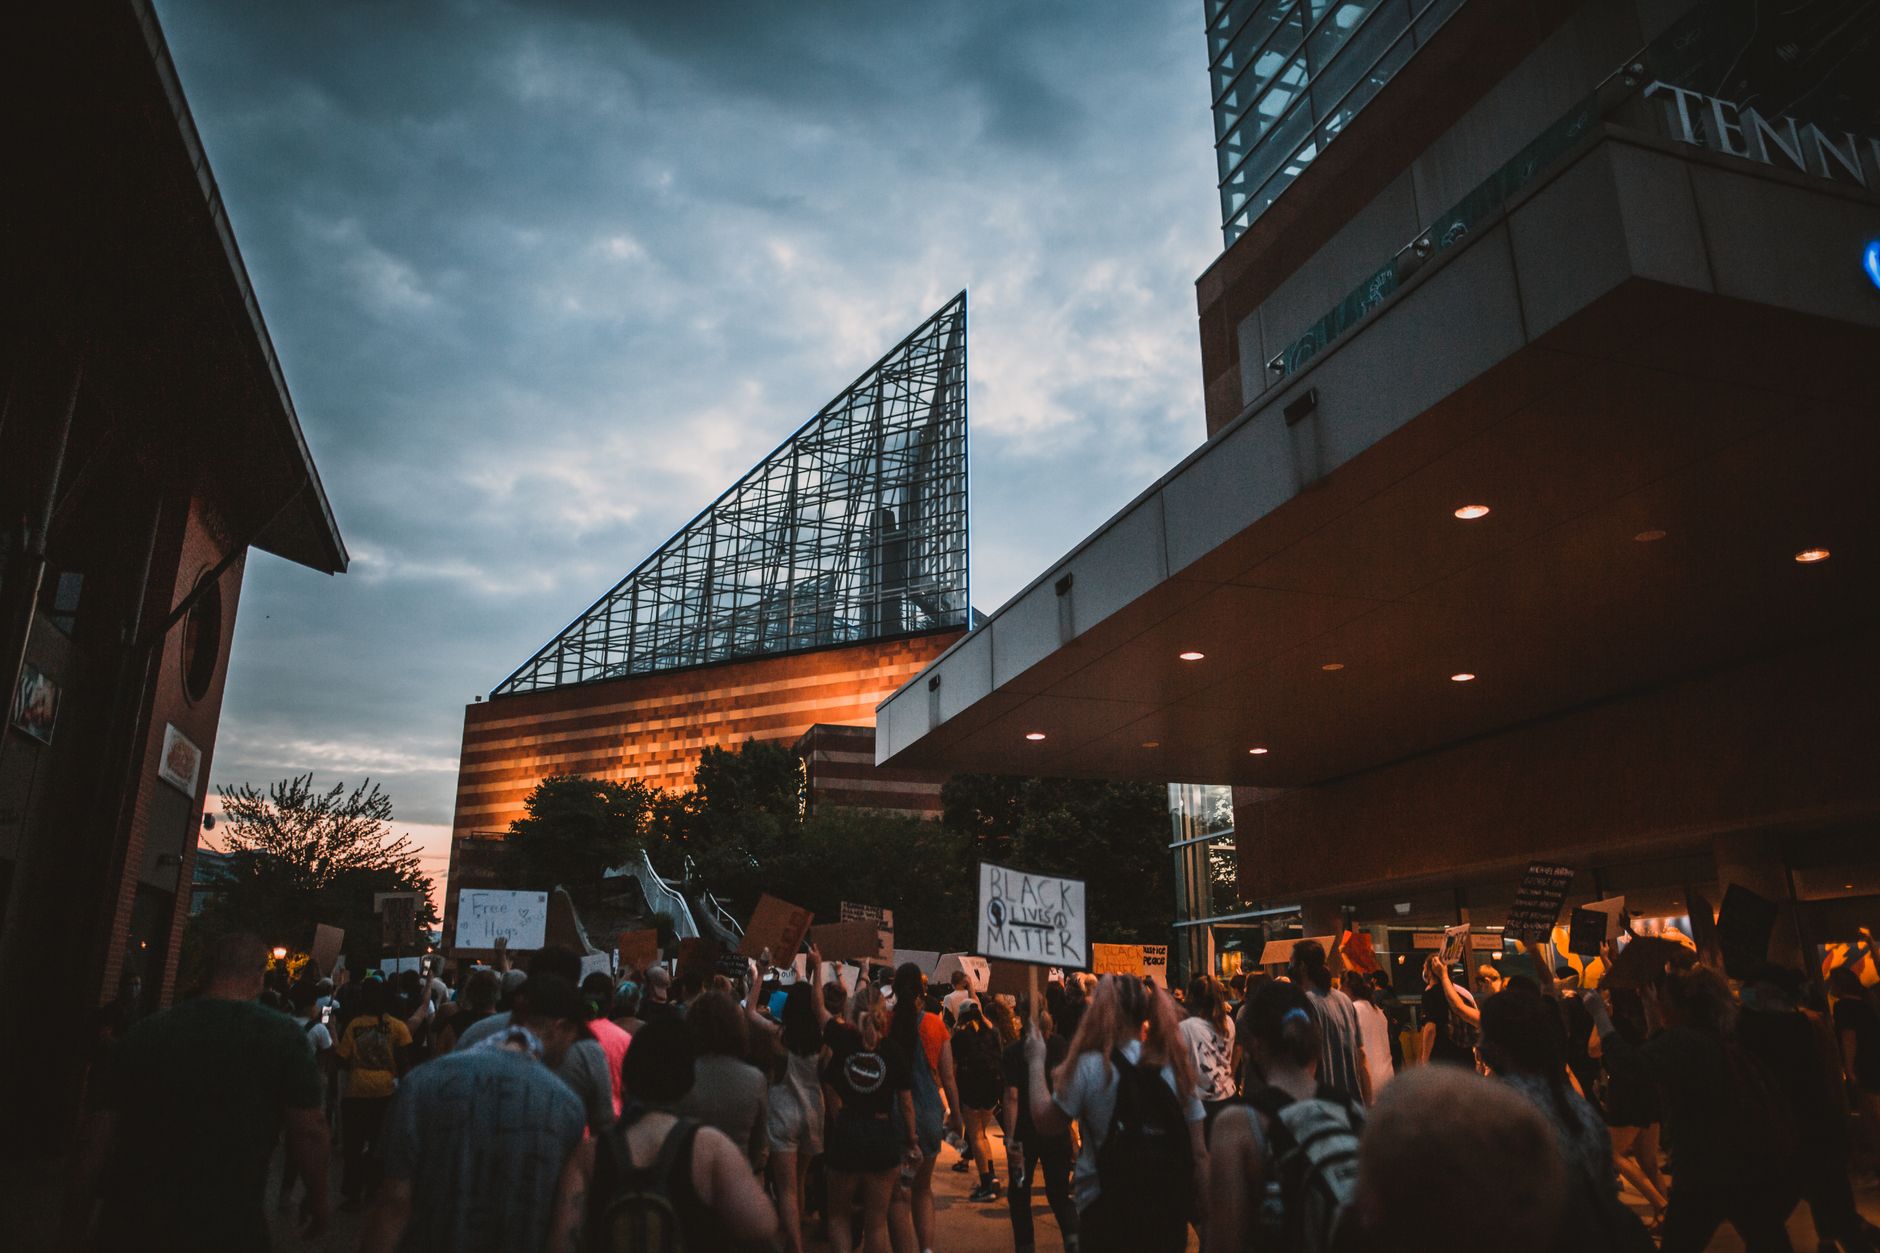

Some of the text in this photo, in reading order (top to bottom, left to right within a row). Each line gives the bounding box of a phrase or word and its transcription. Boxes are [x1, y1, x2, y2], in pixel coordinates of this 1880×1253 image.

[990, 868, 1075, 917] BLACK
[472, 893, 508, 915] Free
[1011, 906, 1051, 924] LIVES
[485, 919, 518, 940] Hugs
[987, 925, 1081, 962] MATTER
